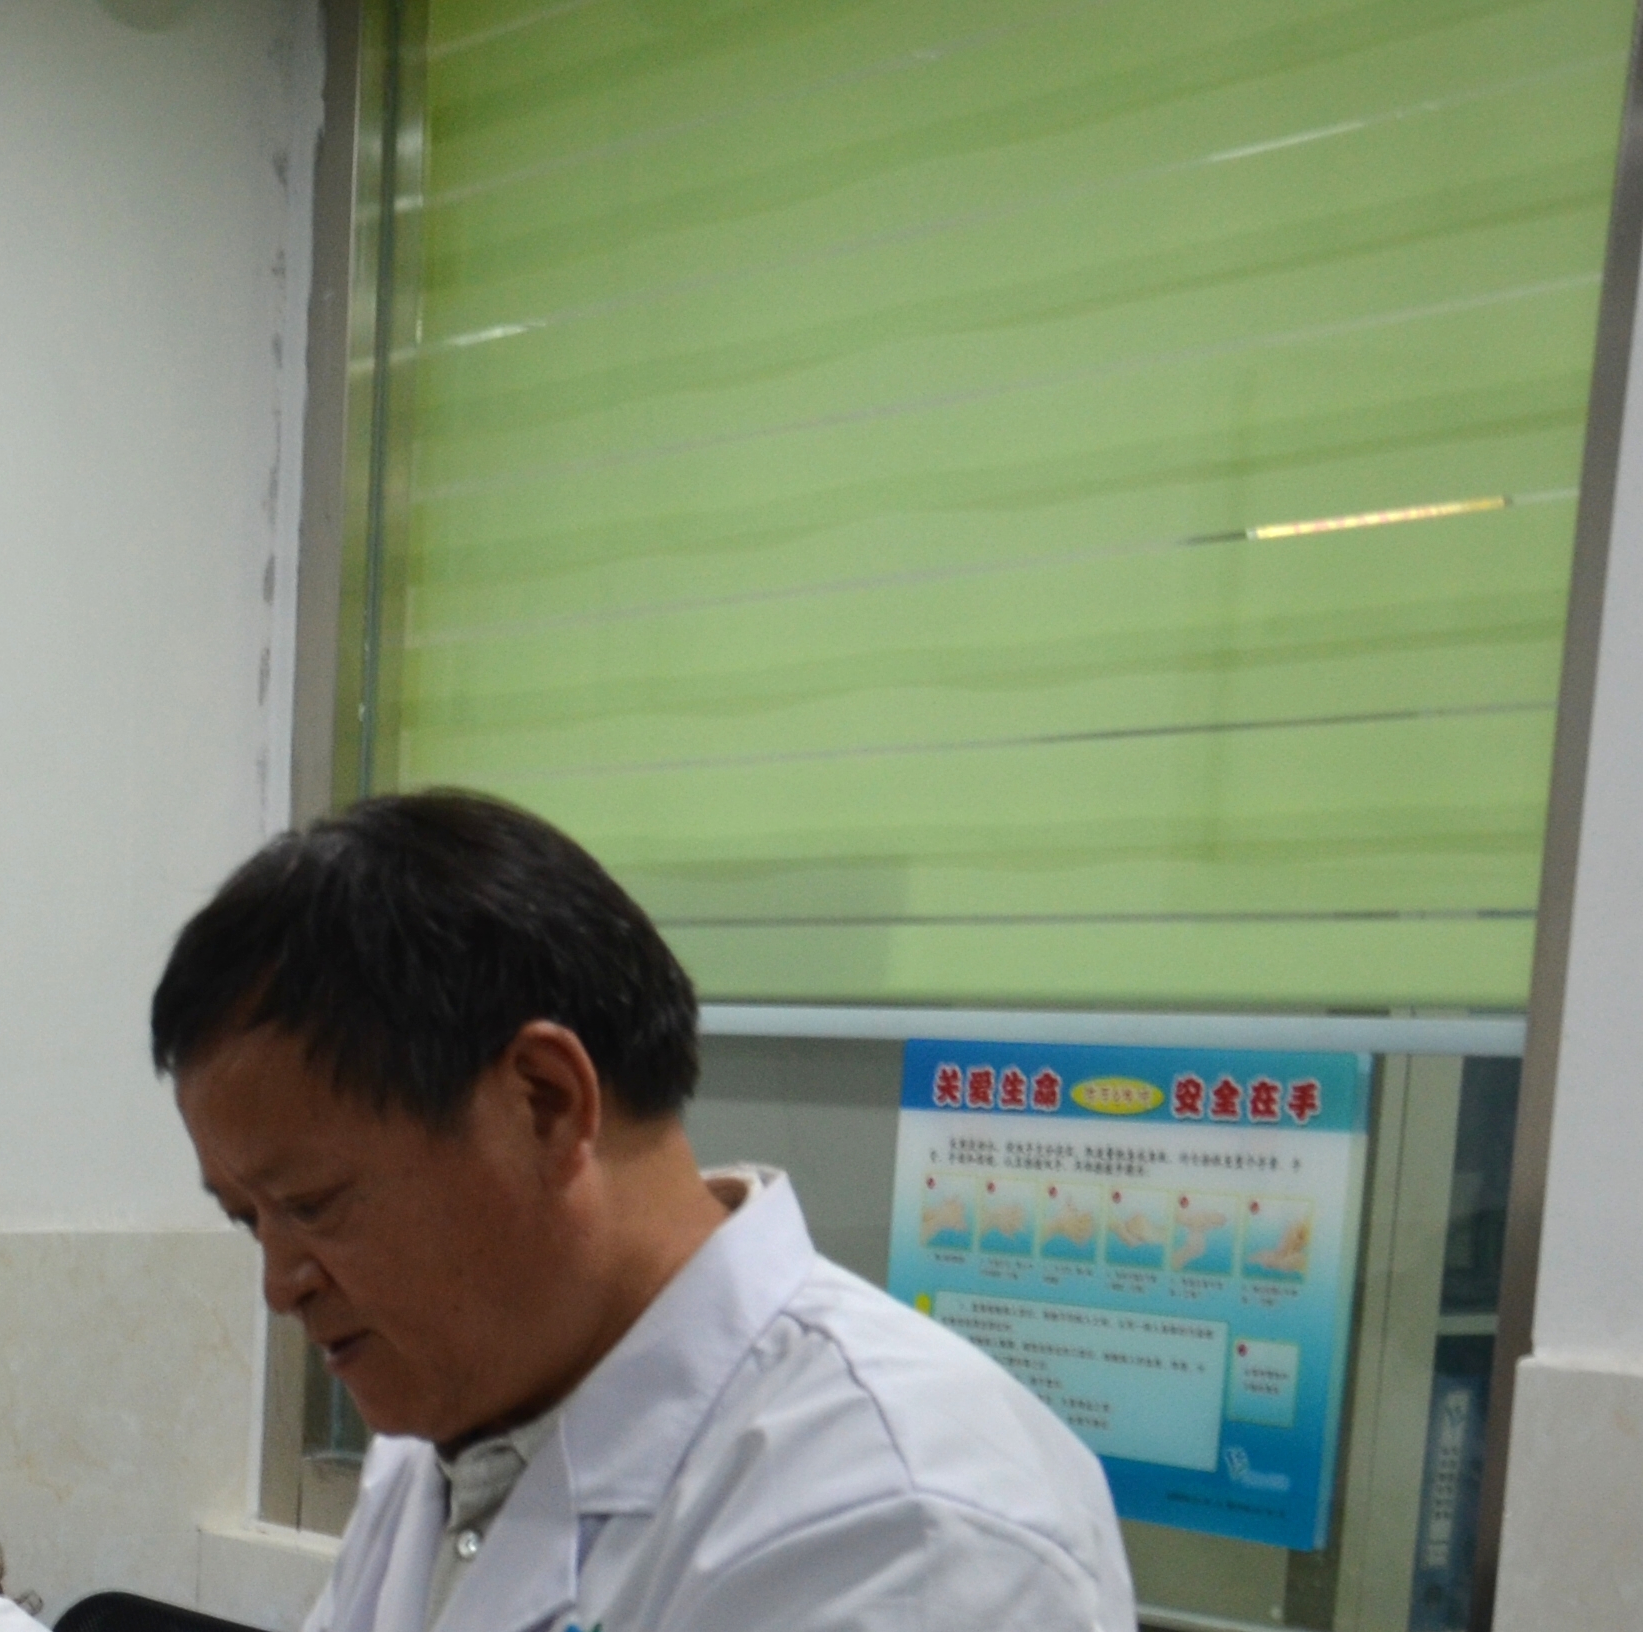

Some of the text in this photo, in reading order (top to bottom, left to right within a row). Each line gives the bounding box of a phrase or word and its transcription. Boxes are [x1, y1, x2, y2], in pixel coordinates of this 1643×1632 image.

[935, 1066, 1319, 1122] 关爱生命 安全在手
